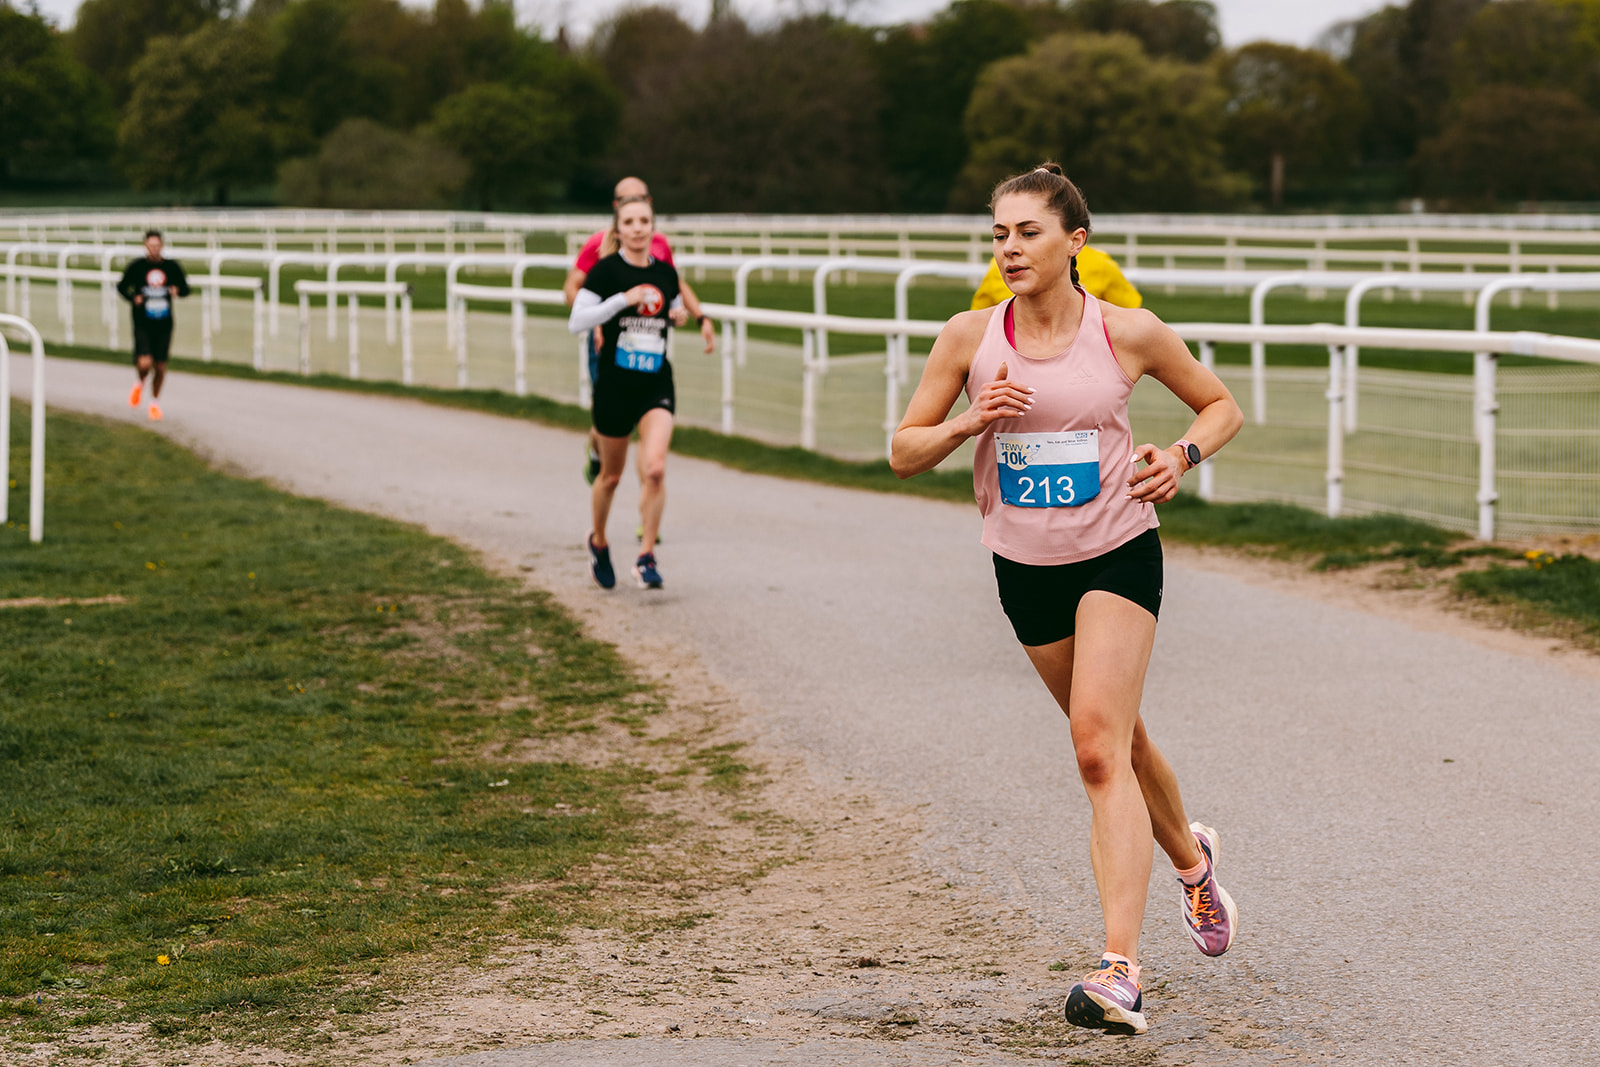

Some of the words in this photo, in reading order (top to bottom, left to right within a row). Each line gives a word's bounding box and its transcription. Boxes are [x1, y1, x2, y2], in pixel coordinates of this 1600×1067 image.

[1000, 443, 1023, 451] TEWV
[1001, 451, 1028, 466] 10k
[1018, 475, 1075, 504] 213
